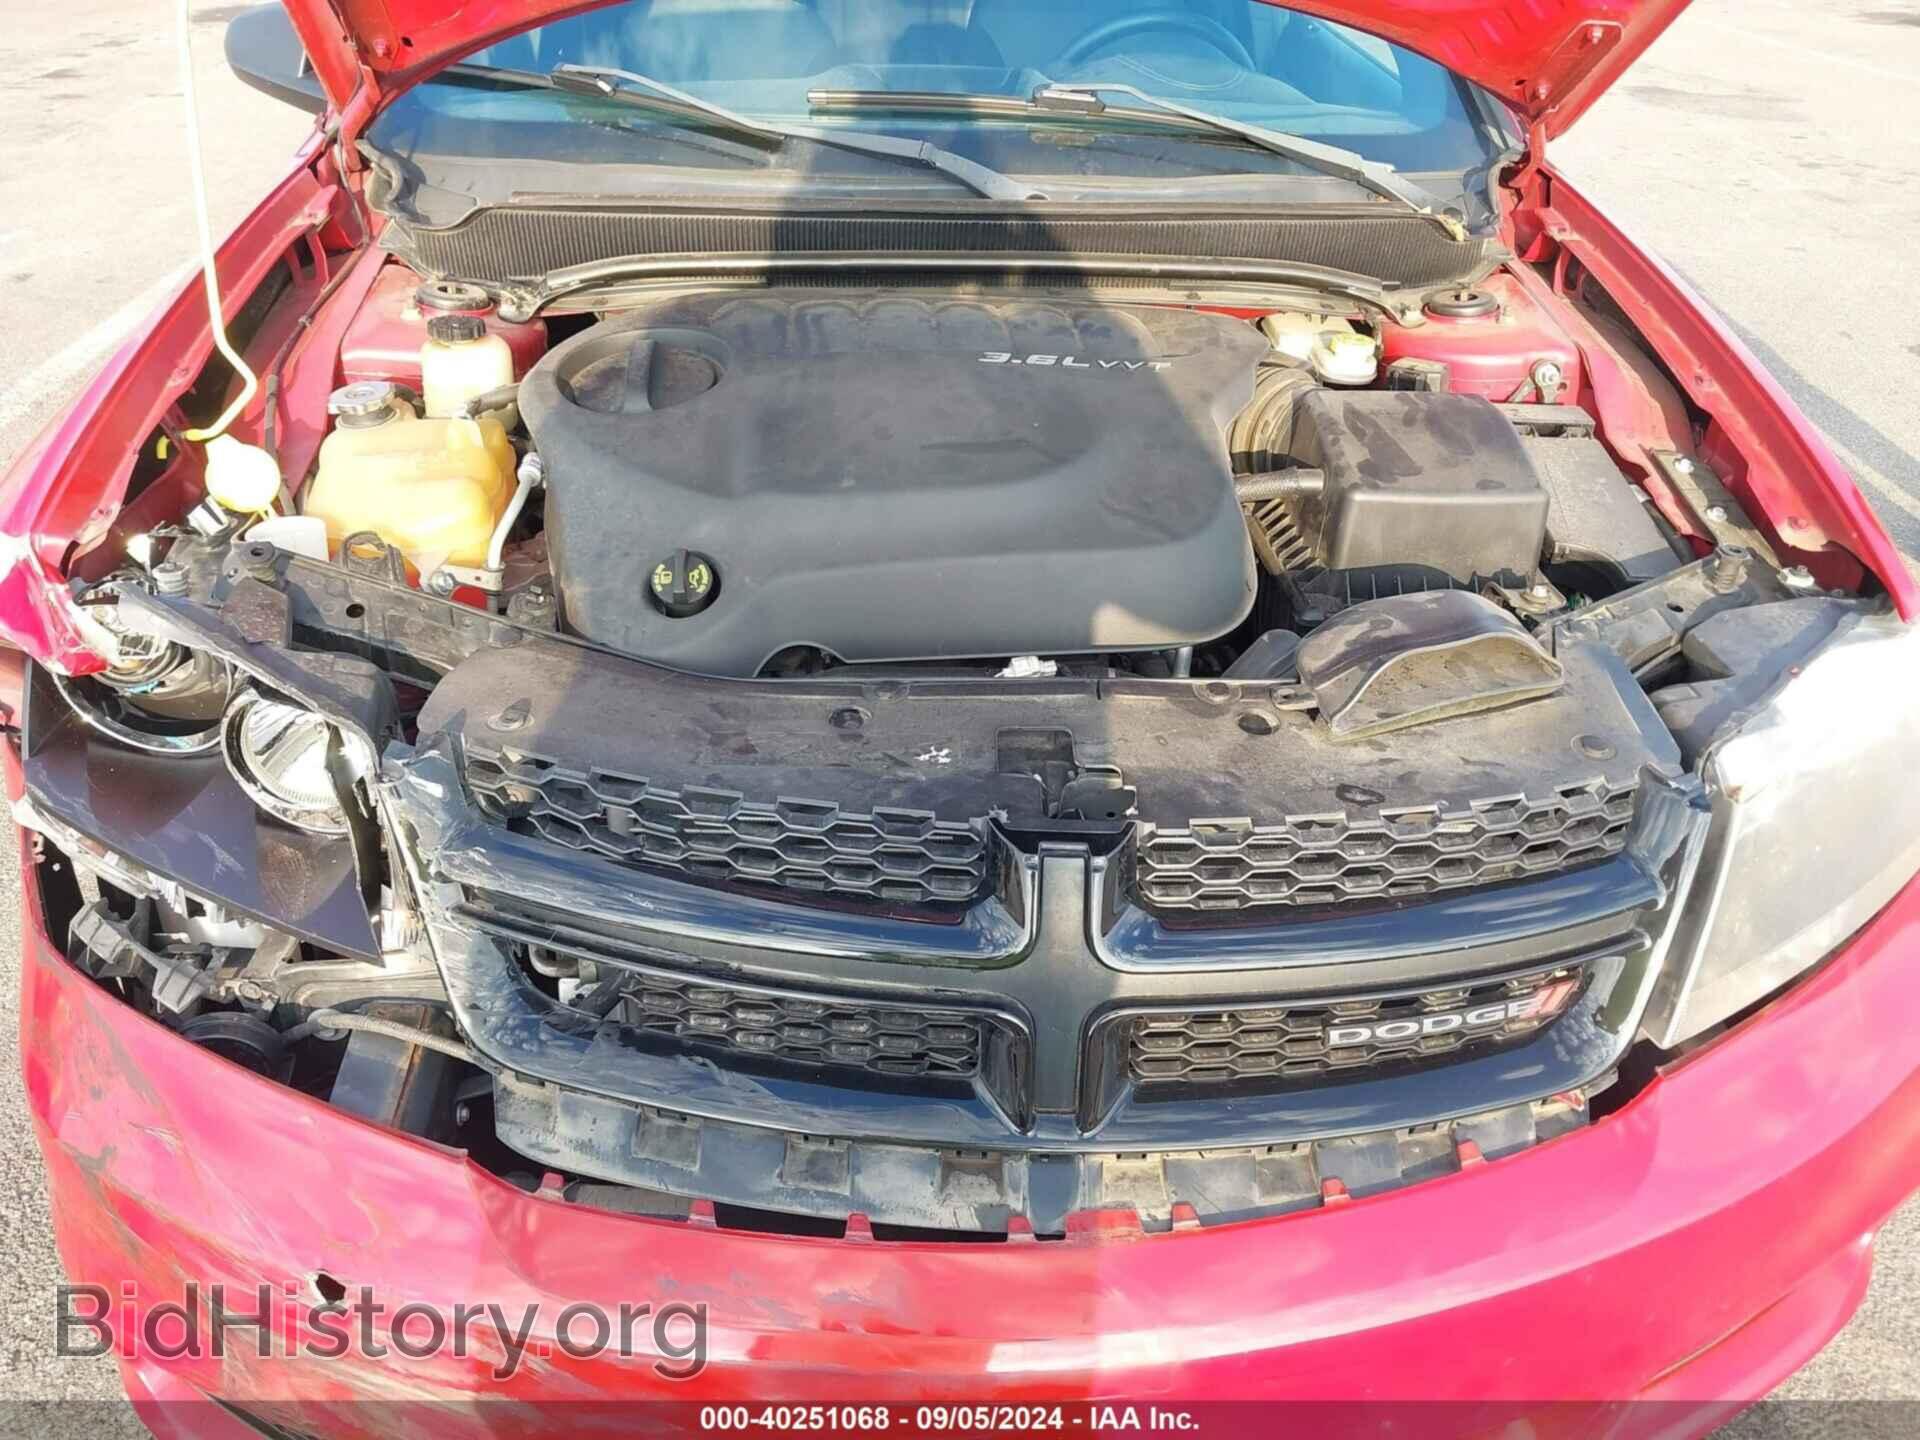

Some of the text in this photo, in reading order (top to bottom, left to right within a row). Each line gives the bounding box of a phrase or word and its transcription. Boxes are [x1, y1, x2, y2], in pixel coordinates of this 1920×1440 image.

[978, 351, 1172, 373] 3.6L VVT
[1329, 999, 1542, 1045] DODGE
